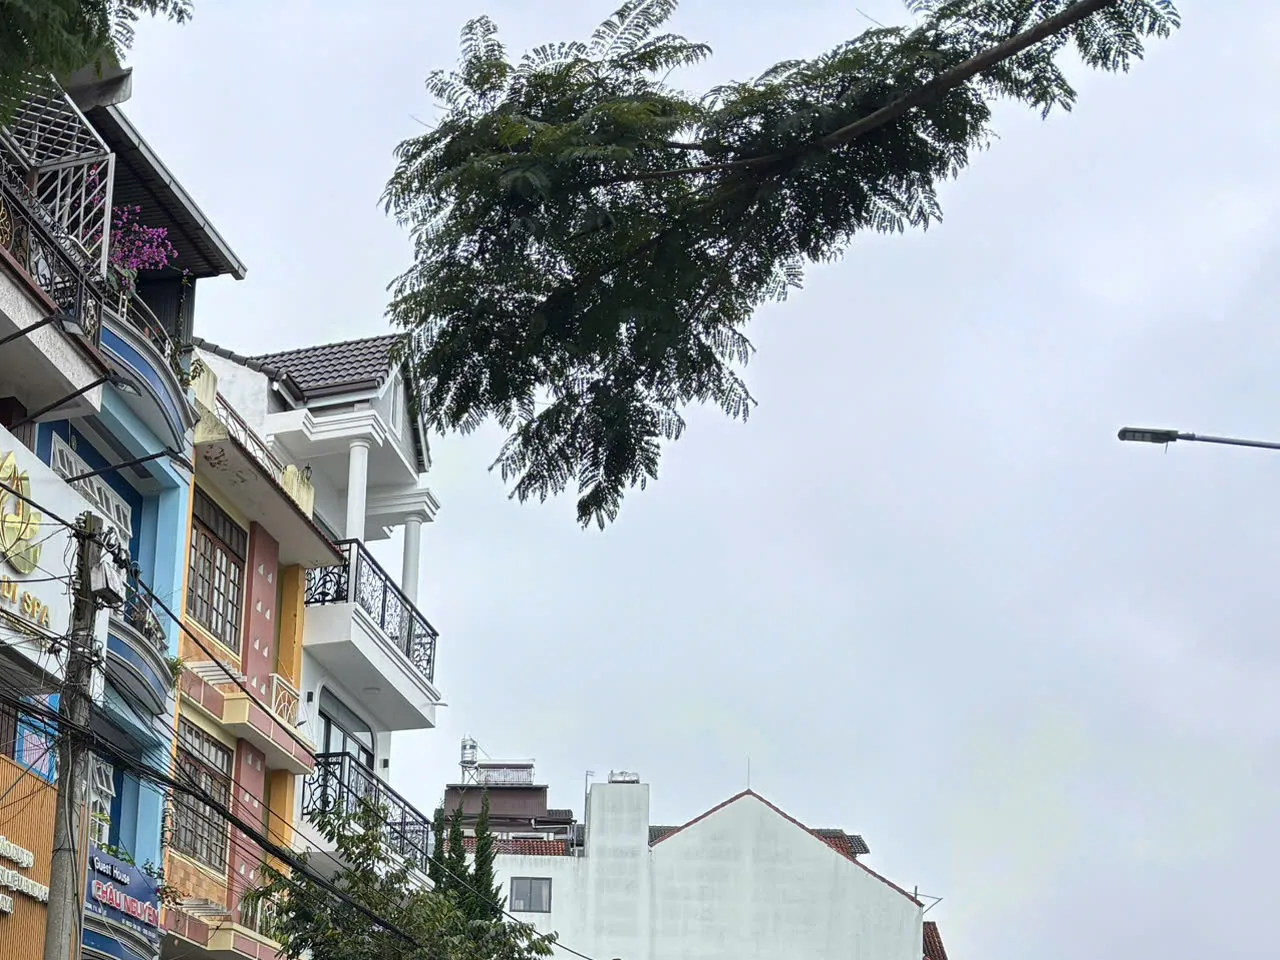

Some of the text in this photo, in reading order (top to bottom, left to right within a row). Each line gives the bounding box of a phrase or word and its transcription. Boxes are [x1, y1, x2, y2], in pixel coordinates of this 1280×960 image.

[22, 591, 50, 628] SPA
[94, 856, 131, 885] Guest House
